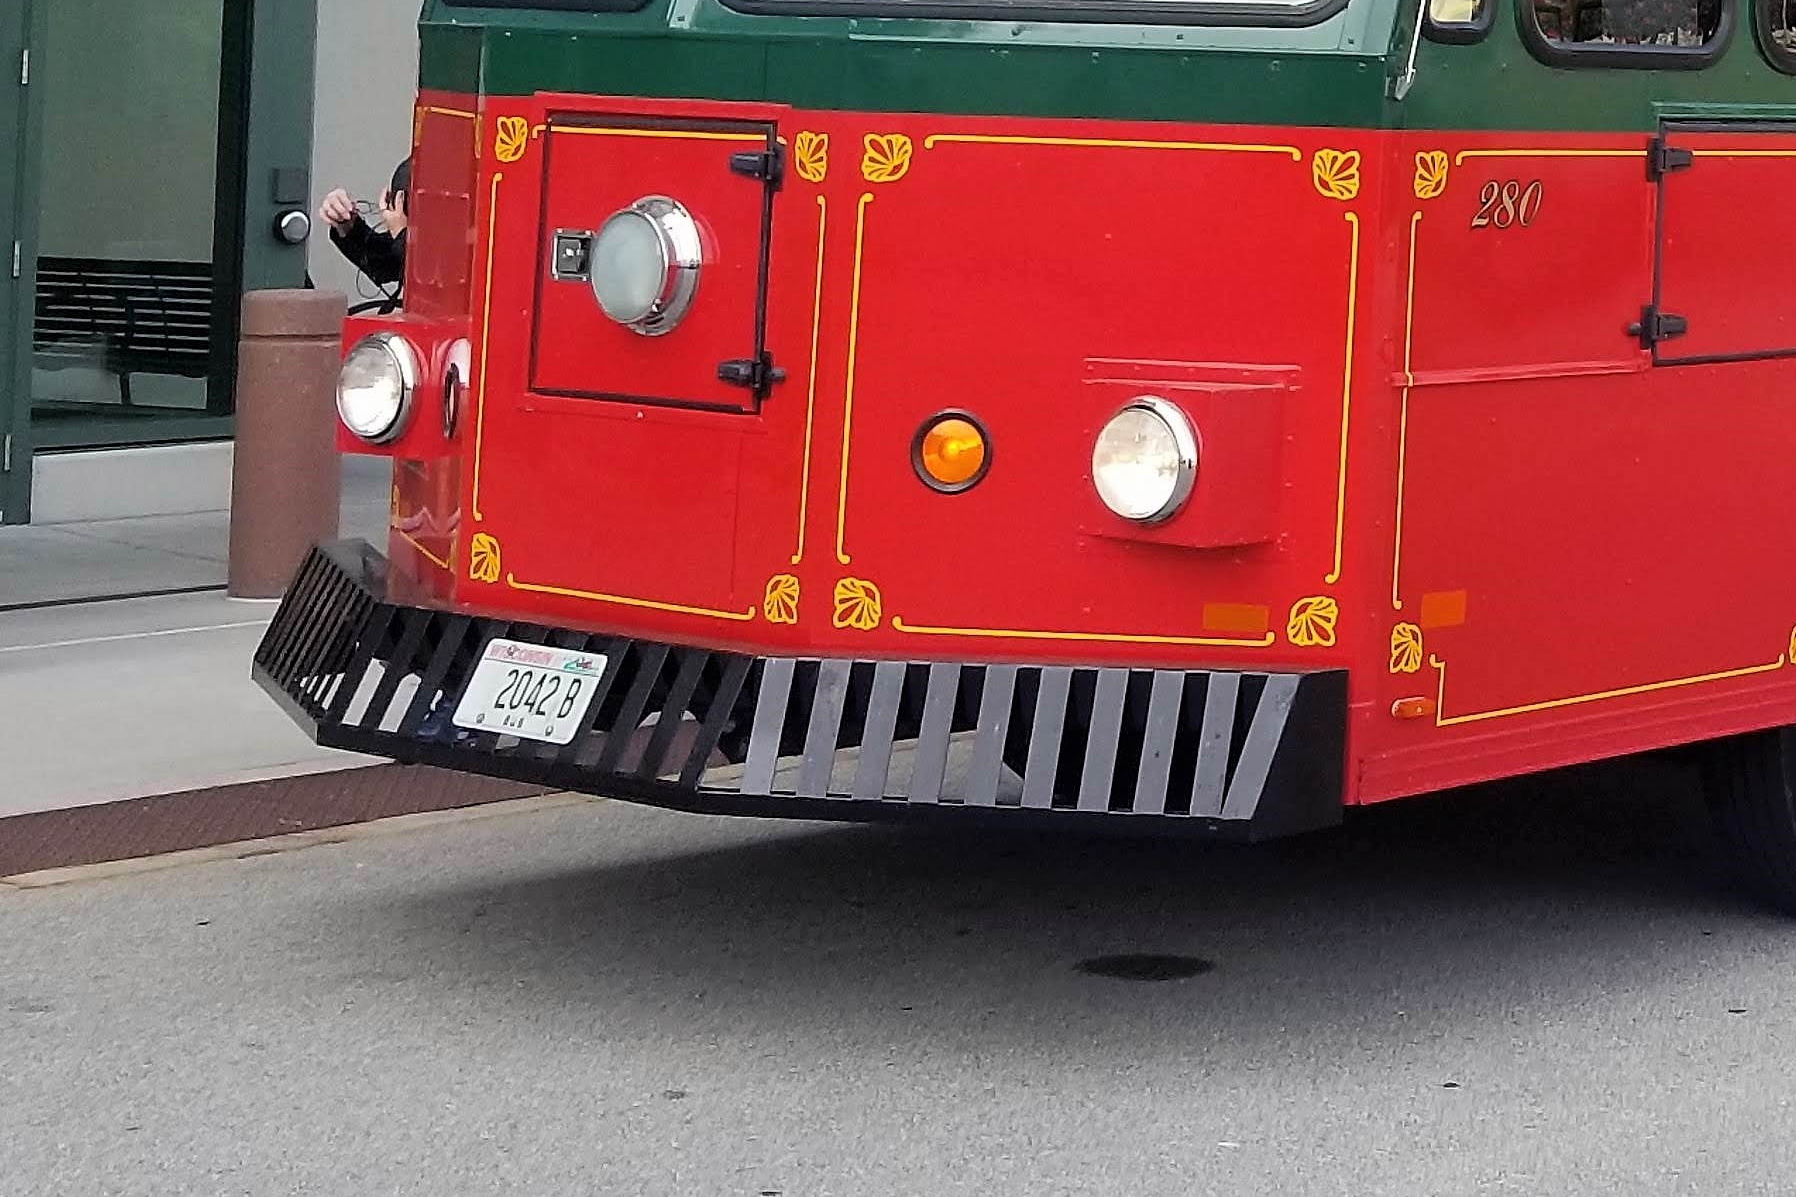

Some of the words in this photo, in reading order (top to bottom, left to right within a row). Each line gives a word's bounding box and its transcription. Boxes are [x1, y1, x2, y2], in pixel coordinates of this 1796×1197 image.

[1471, 179, 1544, 229] 280
[494, 668, 561, 717] 2042
[557, 678, 582, 719] B
